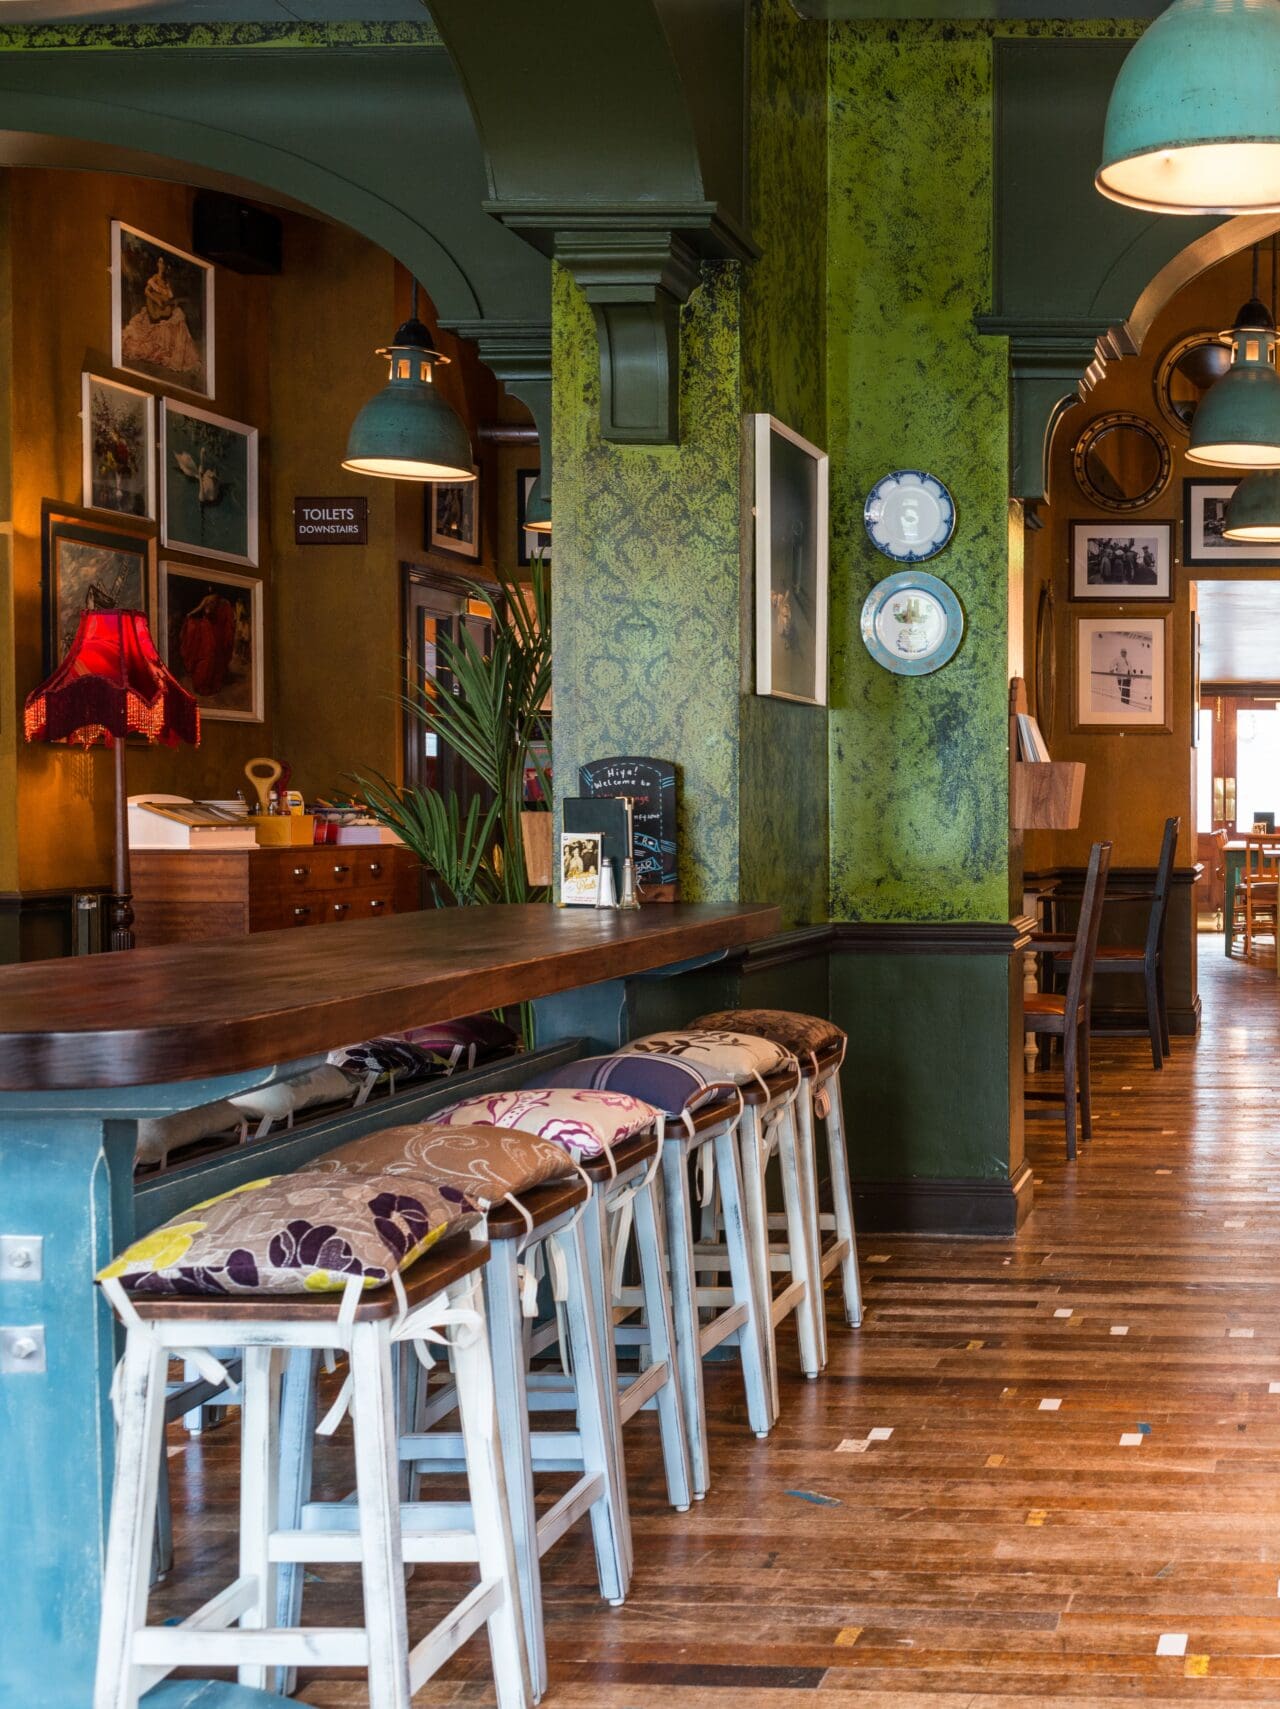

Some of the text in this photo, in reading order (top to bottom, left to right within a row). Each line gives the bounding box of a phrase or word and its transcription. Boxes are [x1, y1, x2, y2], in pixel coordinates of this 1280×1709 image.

[302, 508, 355, 521] TOILETS
[299, 525, 359, 534] DOWNSTAIRS
[607, 766, 638, 779] Hiya!
[594, 780, 636, 790] Welcome
